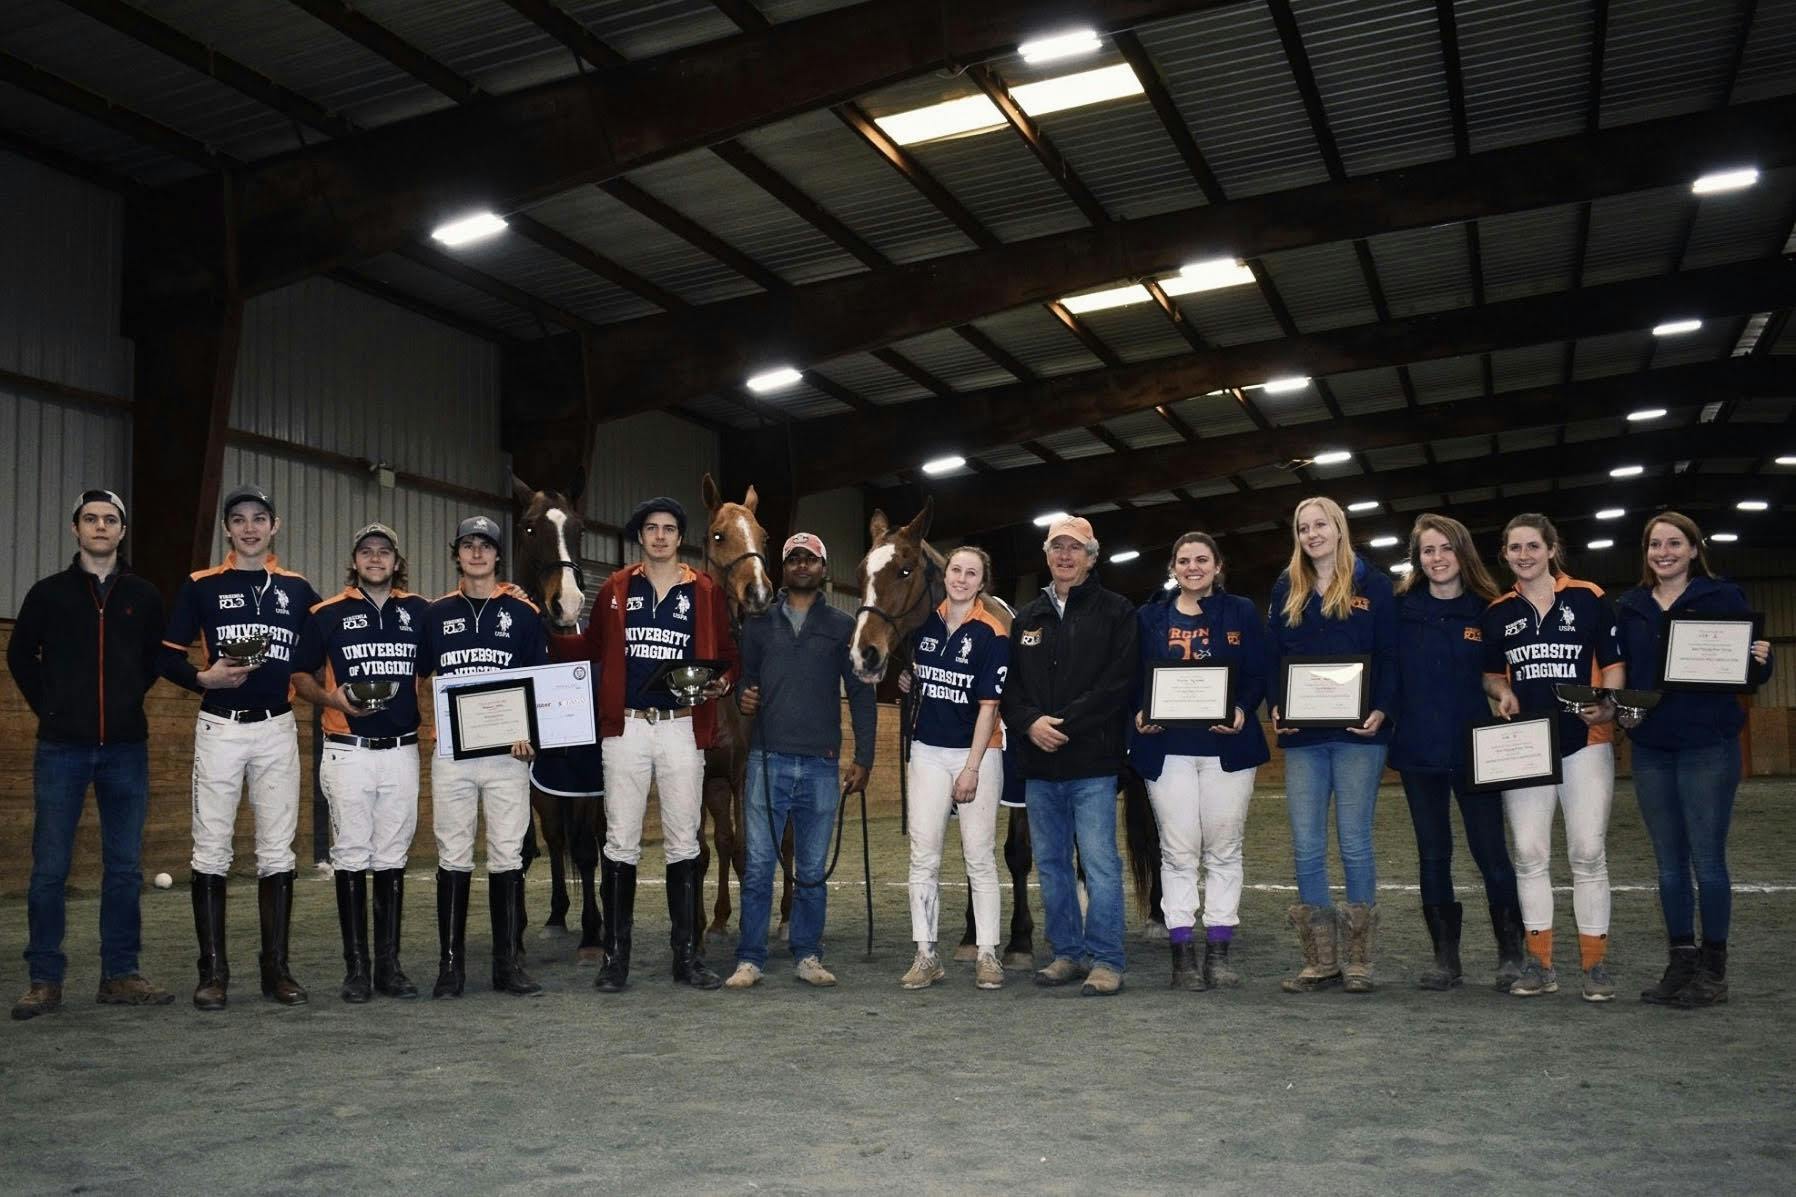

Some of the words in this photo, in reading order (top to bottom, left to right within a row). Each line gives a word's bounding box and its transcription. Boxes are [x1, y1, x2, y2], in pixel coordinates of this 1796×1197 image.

[219, 599, 245, 609] POLO
[626, 601, 643, 611] OLO
[672, 612, 688, 621] USPA
[343, 619, 368, 630] POLO
[443, 622, 466, 635] POLO
[625, 628, 691, 647] NIVERSITY
[1168, 628, 1209, 639] RGIN
[440, 648, 513, 667] UNIVERSITY
[629, 644, 684, 660] VIRGINIA
[348, 665, 360, 677] OF
[914, 664, 975, 688] IVERSITY
[1521, 663, 1577, 680] IRGINIA
[994, 666, 1009, 695] 3
